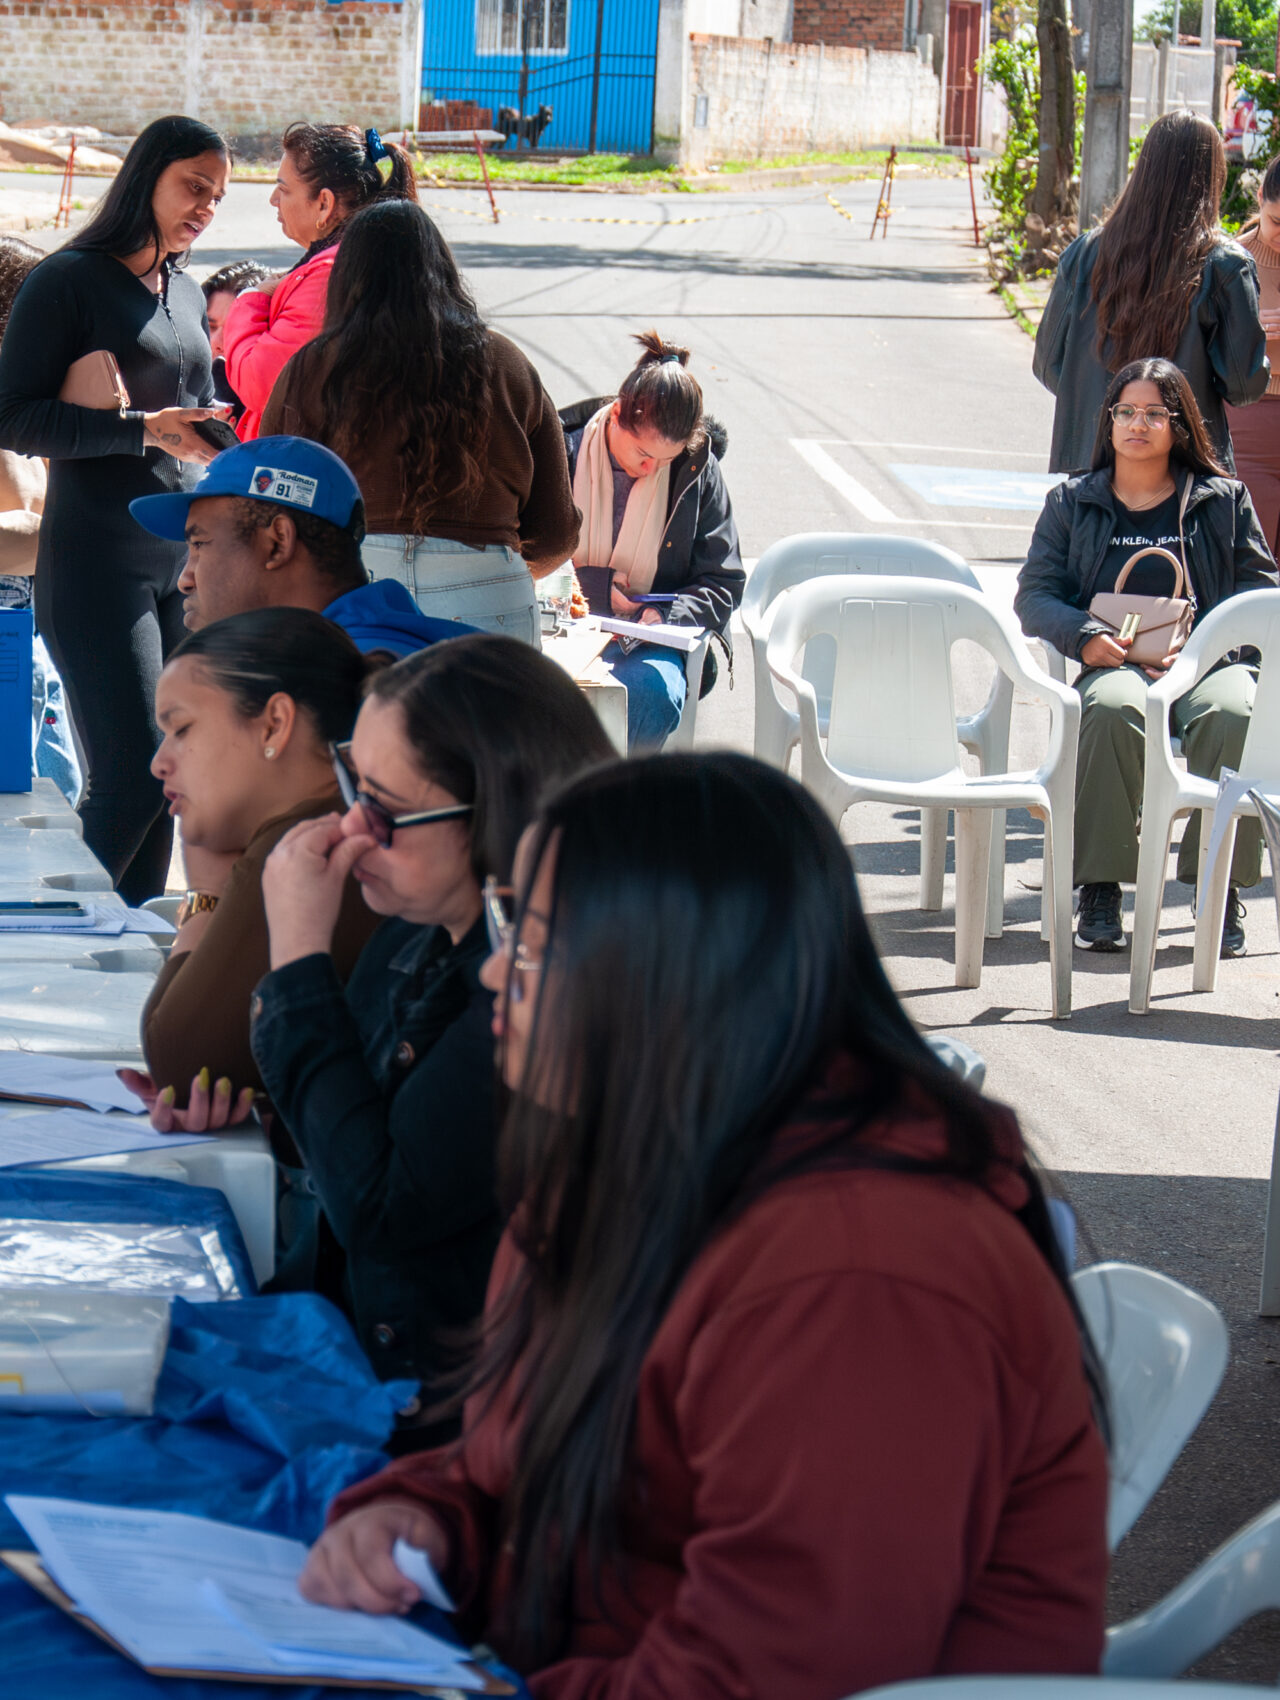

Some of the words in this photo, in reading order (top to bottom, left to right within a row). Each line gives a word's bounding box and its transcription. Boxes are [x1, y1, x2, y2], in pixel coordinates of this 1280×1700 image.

[278, 471, 315, 486] Rodman
[276, 483, 291, 498] 91
[1122, 536, 1153, 546] KLEIN
